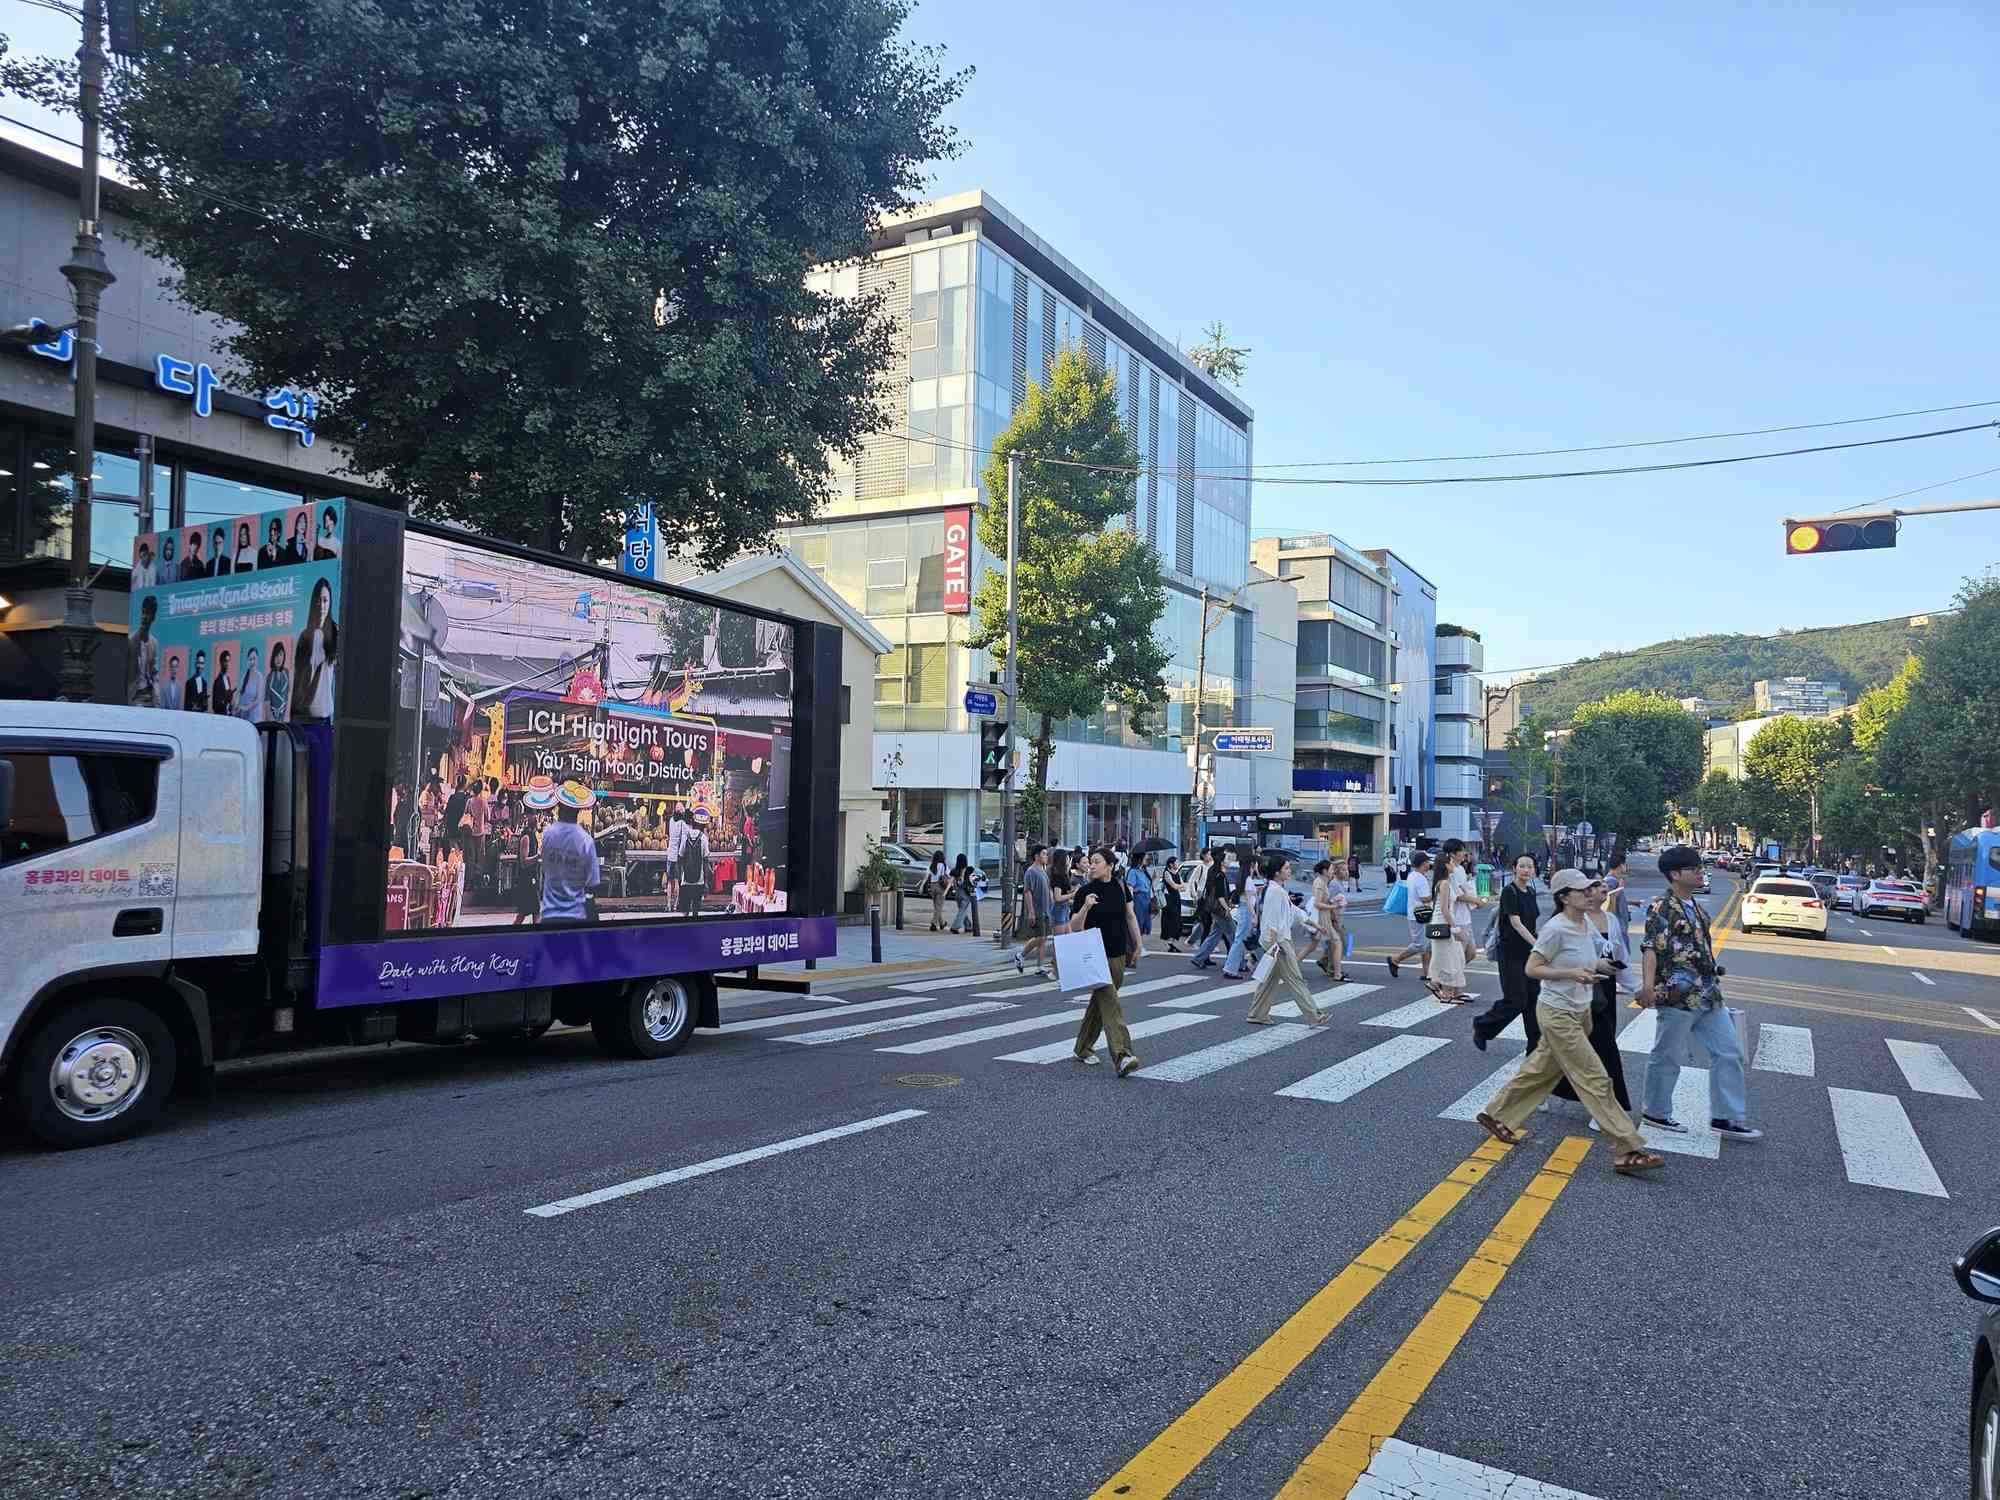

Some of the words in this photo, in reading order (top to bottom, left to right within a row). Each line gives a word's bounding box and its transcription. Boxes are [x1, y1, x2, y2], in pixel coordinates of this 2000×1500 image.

[946, 524, 966, 595] GATE
[528, 709, 565, 735] ICH
[572, 716, 659, 748] Highlight
[664, 726, 708, 751] Tours
[534, 751, 564, 771] Yau
[569, 754, 600, 774] Tsim
[605, 761, 644, 780] Mong
[649, 762, 694, 780] District
[25, 869, 84, 884] 홍콩과의
[89, 868, 131, 882] 데이트
[721, 935, 765, 956] 홍콩과의
[768, 933, 799, 951] 데이트
[379, 961, 415, 979] Date
[418, 959, 448, 976] with
[450, 955, 484, 979] Hong
[488, 953, 519, 976] Kong
